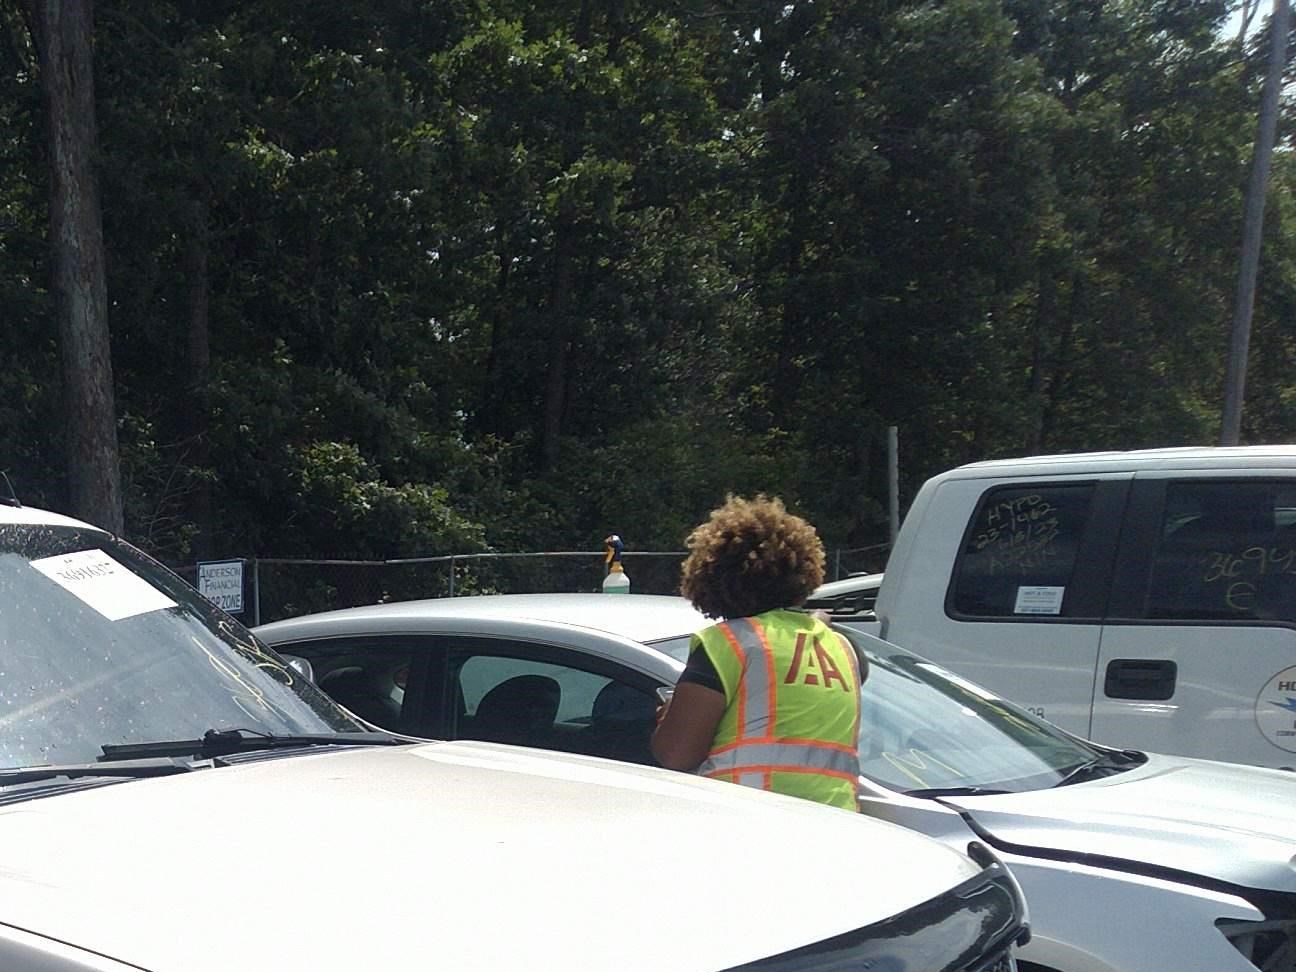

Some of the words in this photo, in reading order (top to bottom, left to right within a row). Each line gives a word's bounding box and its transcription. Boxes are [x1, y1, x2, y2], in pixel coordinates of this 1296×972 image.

[200, 567, 241, 578] ANDERSON
[204, 579, 241, 593] FINANCIAL
[221, 594, 241, 608] ZONE
